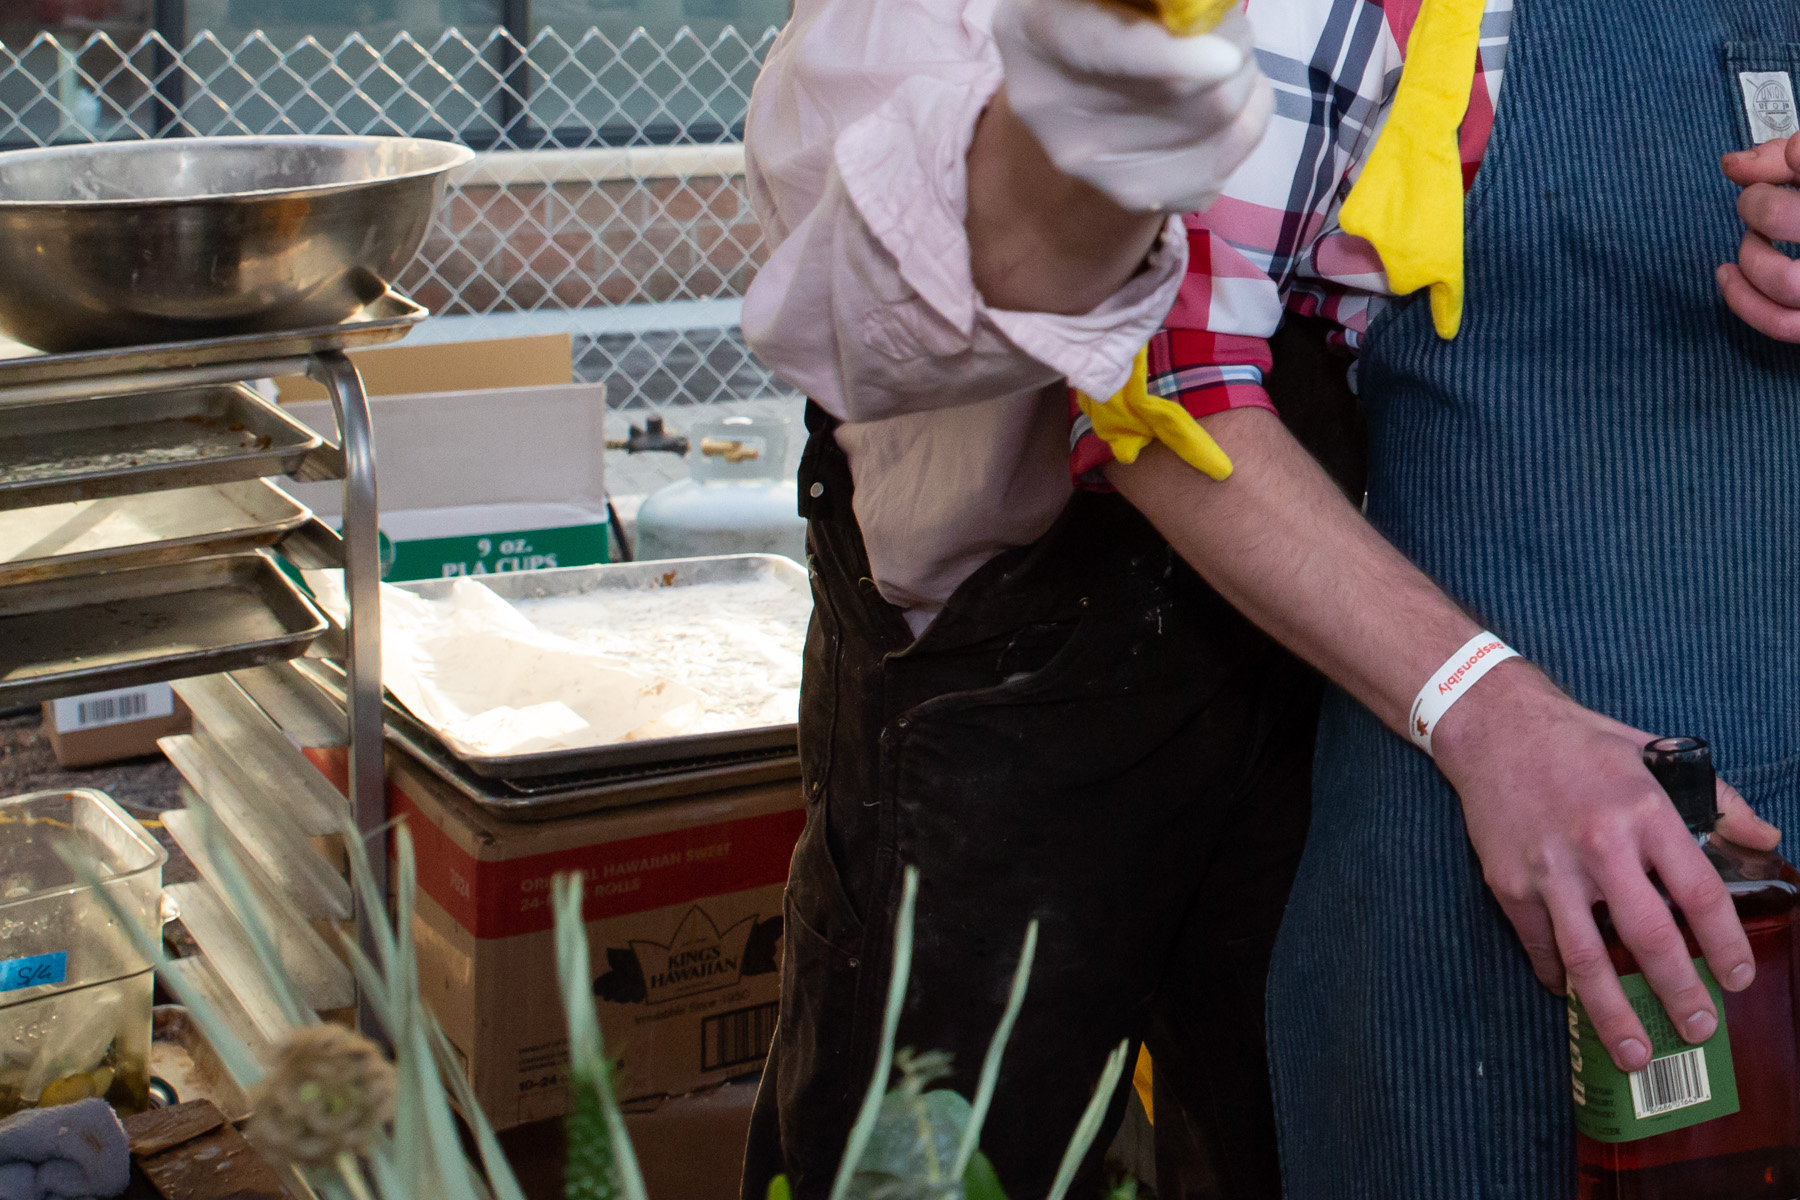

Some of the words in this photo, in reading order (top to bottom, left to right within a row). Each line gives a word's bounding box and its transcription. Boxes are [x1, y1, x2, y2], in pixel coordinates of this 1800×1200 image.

[476, 538, 493, 558] 9
[1437, 641, 1506, 696] Responsibly
[593, 877, 641, 900] ROLLS
[649, 956, 739, 990] HAWAIIAN
